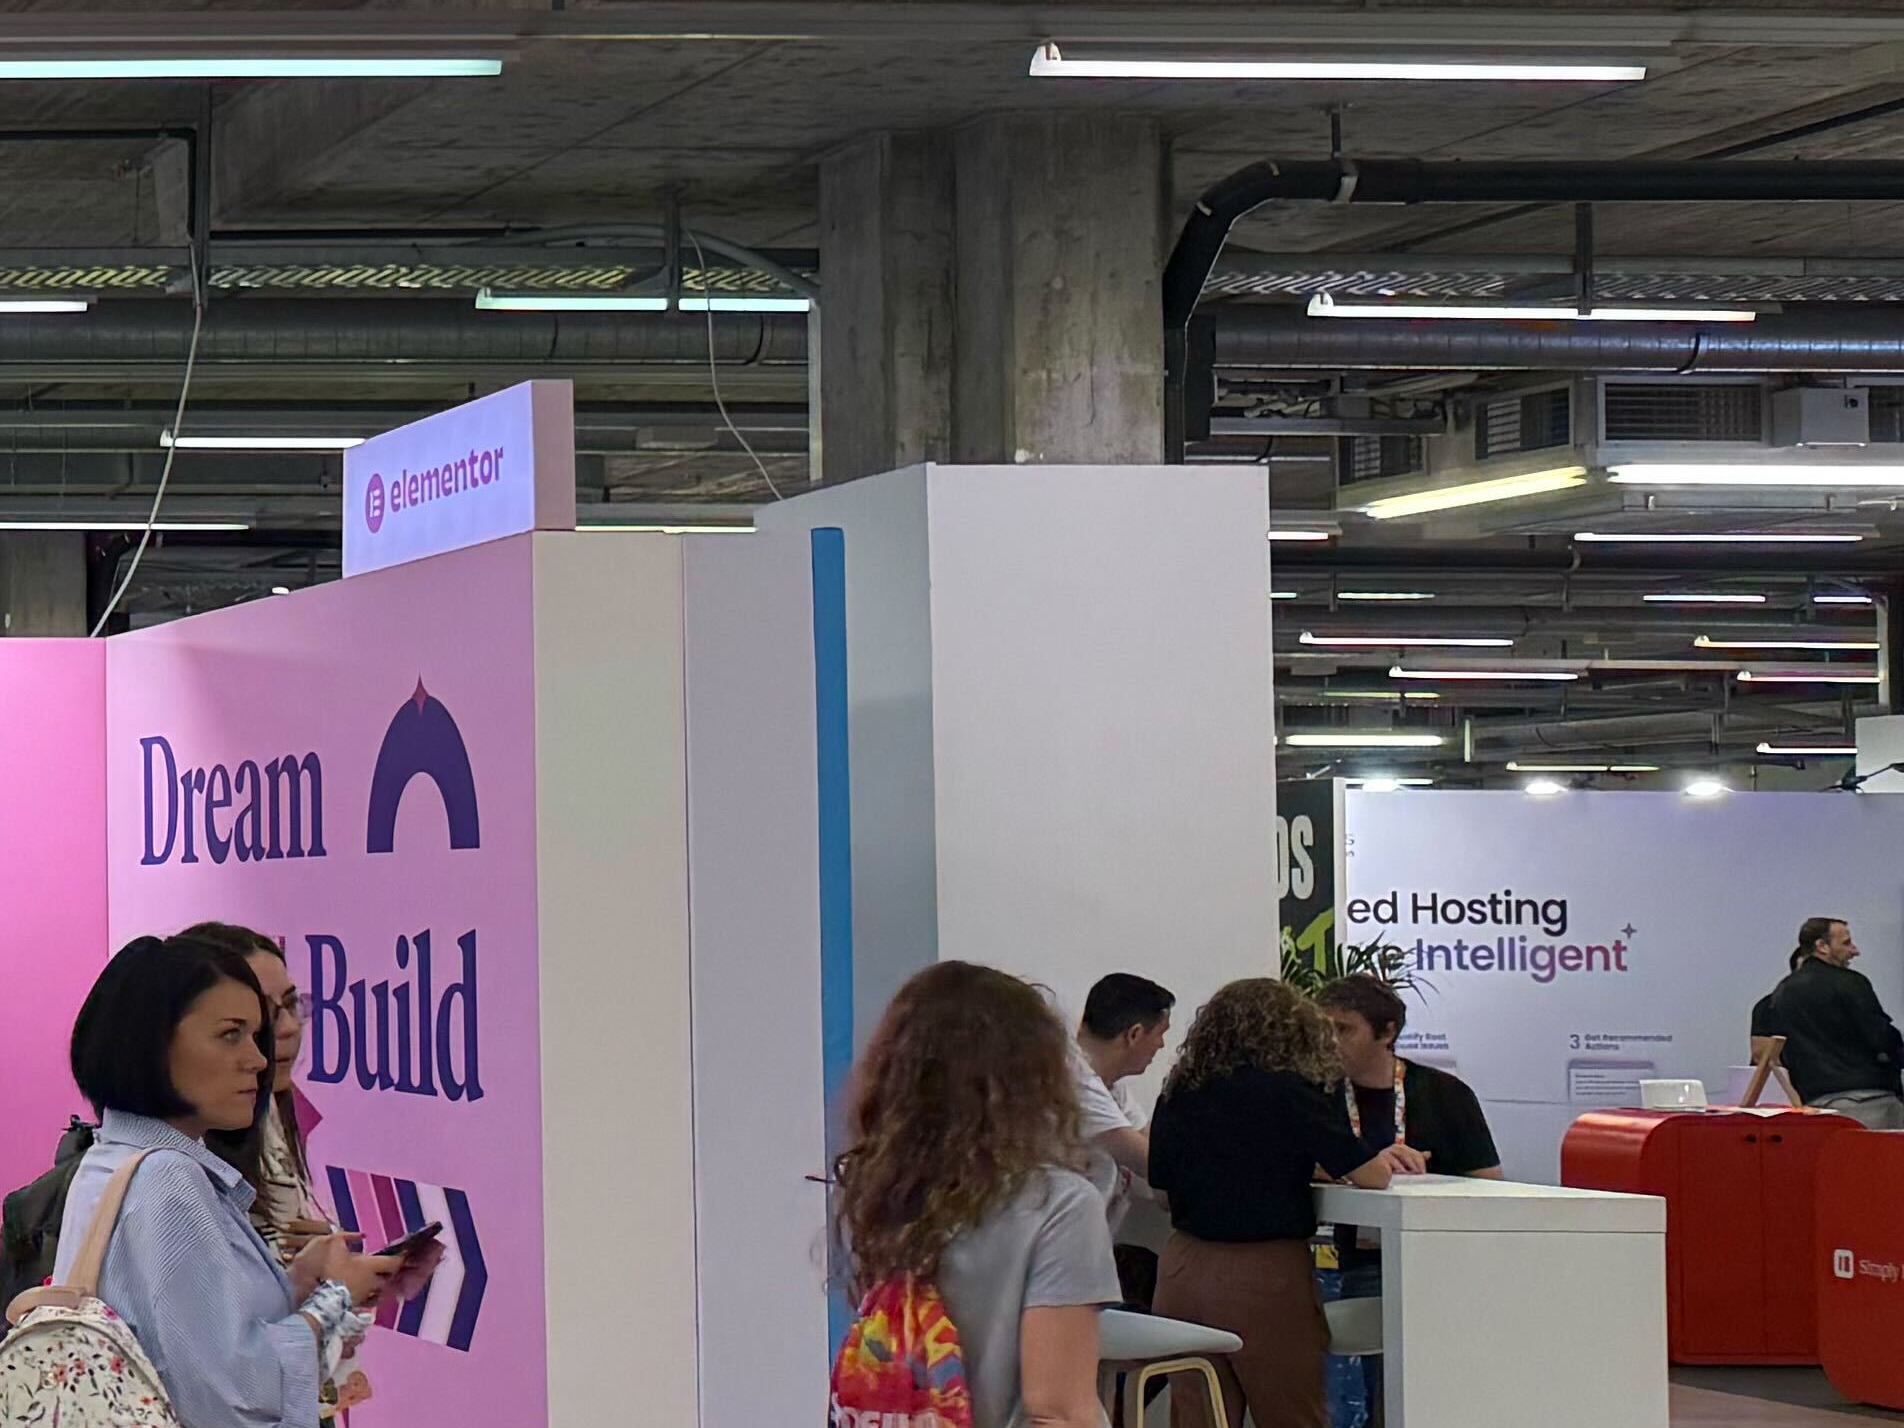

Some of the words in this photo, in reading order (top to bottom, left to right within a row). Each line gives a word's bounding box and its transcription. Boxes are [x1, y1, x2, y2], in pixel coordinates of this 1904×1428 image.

[390, 446, 504, 512] elementor
[139, 735, 328, 866] Dream
[1411, 889, 1568, 937] Hosting
[1416, 935, 1628, 983] Intelligent
[305, 928, 484, 1102] Build
